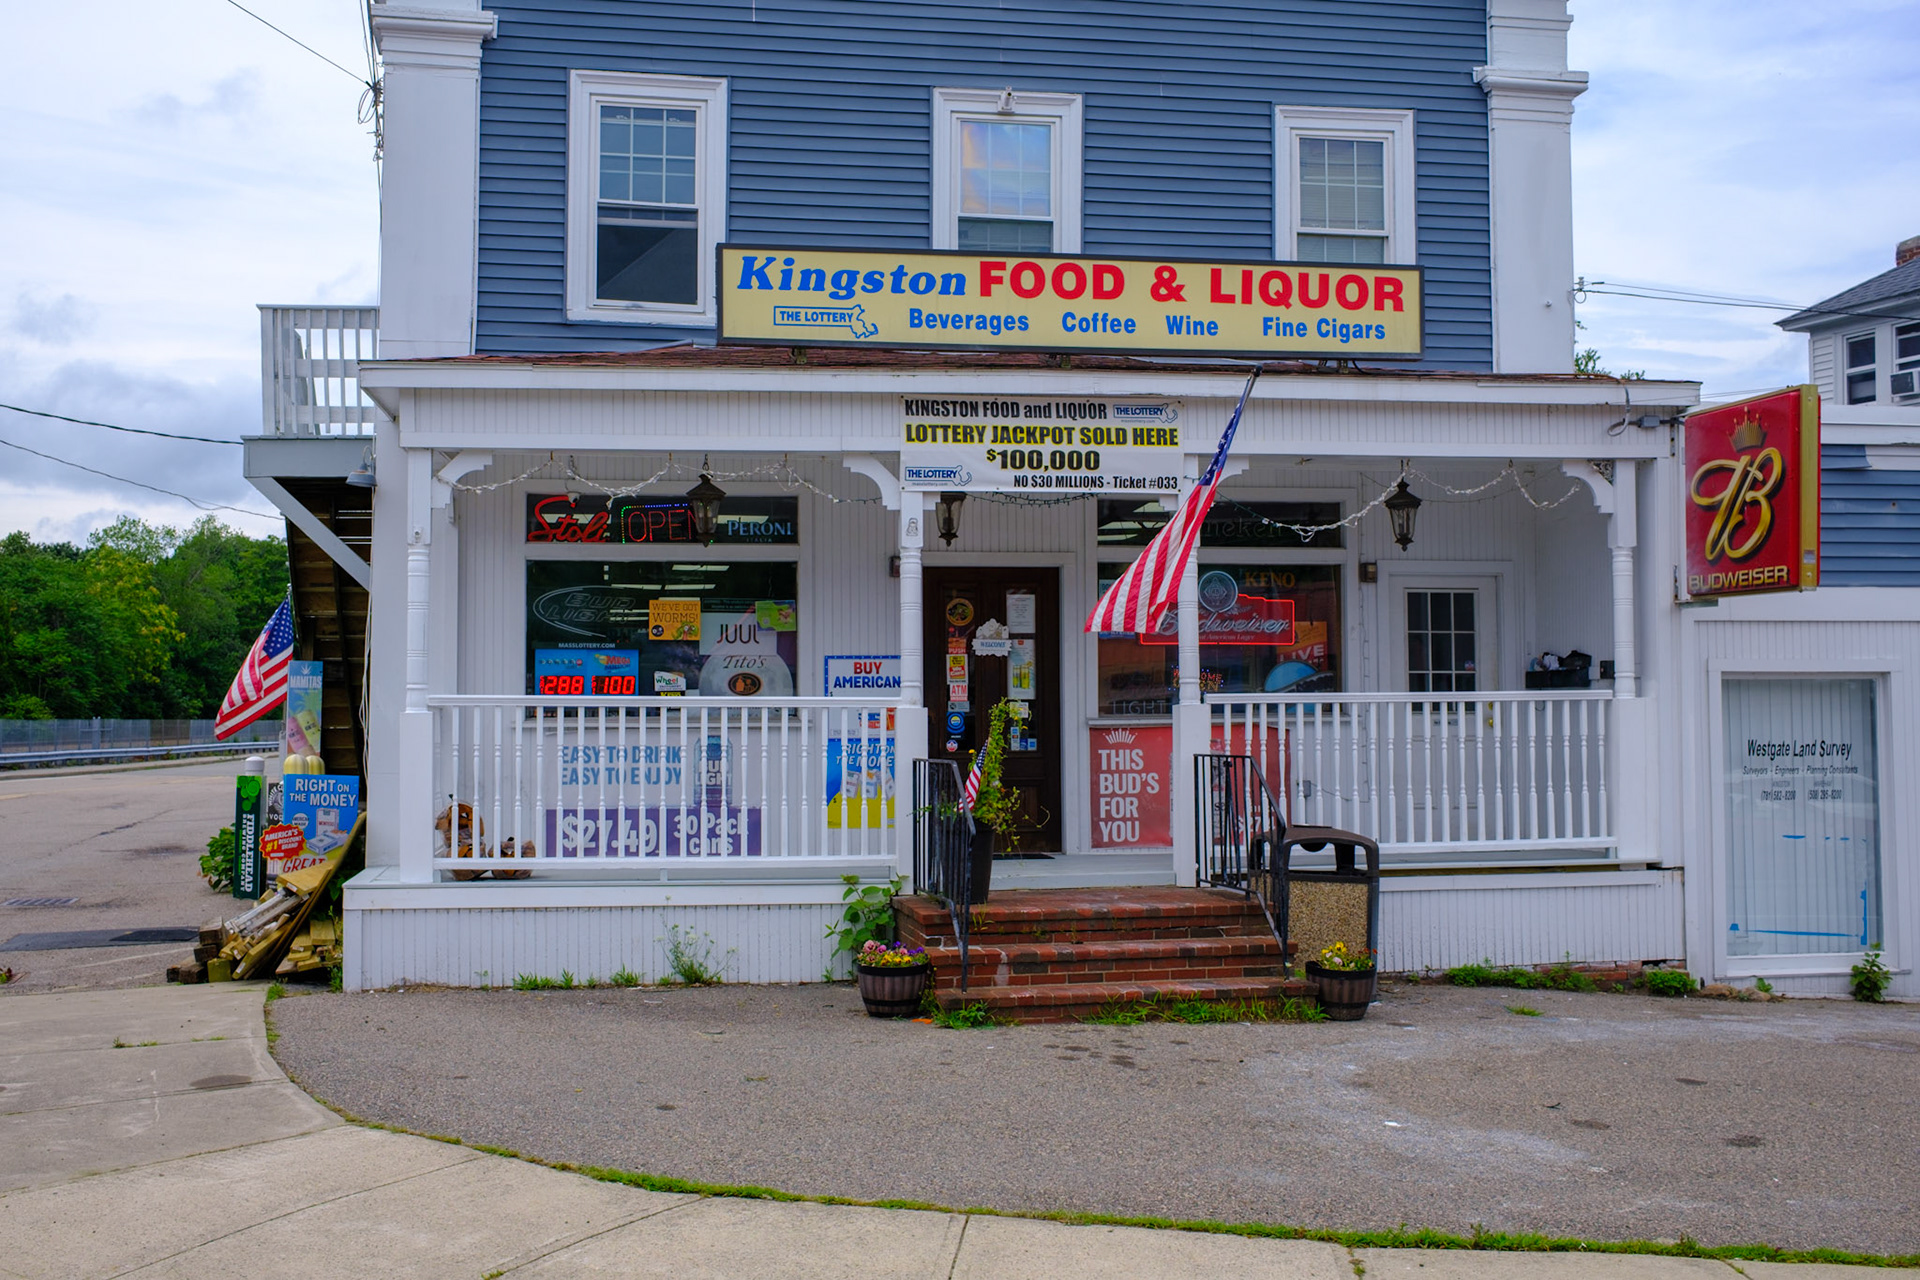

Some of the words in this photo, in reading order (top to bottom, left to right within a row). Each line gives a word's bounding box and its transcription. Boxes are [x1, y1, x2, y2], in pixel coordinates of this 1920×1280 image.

[737, 256, 967, 300] Kingston
[979, 260, 1125, 300] FOOD
[1150, 265, 1187, 302] &
[1210, 268, 1405, 312] LIQUOR
[779, 310, 801, 322] THE
[804, 311, 853, 323] LOTTERY
[909, 308, 1029, 336] Beverages
[1062, 312, 1137, 334] Coffee
[1166, 315, 1219, 336] Wine
[1262, 317, 1308, 337] Fine
[1316, 318, 1386, 343] Cigars
[904, 399, 979, 418] KINGSTON
[983, 401, 1020, 419] FOOD
[1023, 403, 1052, 419] and
[1055, 402, 1108, 421] LIQUOR
[1115, 406, 1130, 416] THE
[1132, 407, 1164, 417] LOTTERY
[905, 423, 987, 444] LOTTERY
[990, 425, 1076, 446] JACKPOT
[1079, 426, 1128, 447] SOLD
[1131, 427, 1179, 447] HERE
[986, 448, 1101, 472] $100,000
[907, 469, 923, 479] THE
[924, 469, 958, 479] LOTTERY
[1013, 475, 1028, 488] NO
[1031, 475, 1053, 489] $30
[1055, 475, 1105, 489] MILLIONS
[1112, 476, 1147, 490] Ticket
[1148, 477, 1178, 490] #033
[527, 495, 611, 543] Stoli
[1244, 571, 1296, 588] KENO
[1688, 565, 1790, 592] BUDWEISER
[682, 602, 699, 612] GOT
[651, 612, 699, 624] WORMS!
[722, 655, 768, 669] Tito's
[853, 661, 883, 675] BUY
[545, 675, 585, 695] 288
[833, 675, 901, 689] AMERICAN
[951, 684, 968, 696] ATM
[562, 745, 600, 765] EASY
[1747, 739, 1790, 760] Westgate
[1793, 740, 1817, 757] Land
[1819, 740, 1852, 760] Survey
[1098, 748, 1145, 771] THIS
[562, 766, 600, 786] EASY
[1742, 765, 1769, 777] Surveyors
[1774, 765, 1800, 777] Engineers
[295, 778, 337, 793] RIGHT
[337, 784, 350, 793] ON
[1099, 772, 1160, 795] BUD'S
[289, 793, 307, 803] THE
[309, 793, 357, 808] MONEY
[1099, 797, 1140, 819] FOR
[265, 828, 299, 842] AMERICA'S
[1099, 821, 1141, 843] YOU
[245, 813, 255, 893] FIDDLEHEAD
[265, 840, 279, 853] #1
